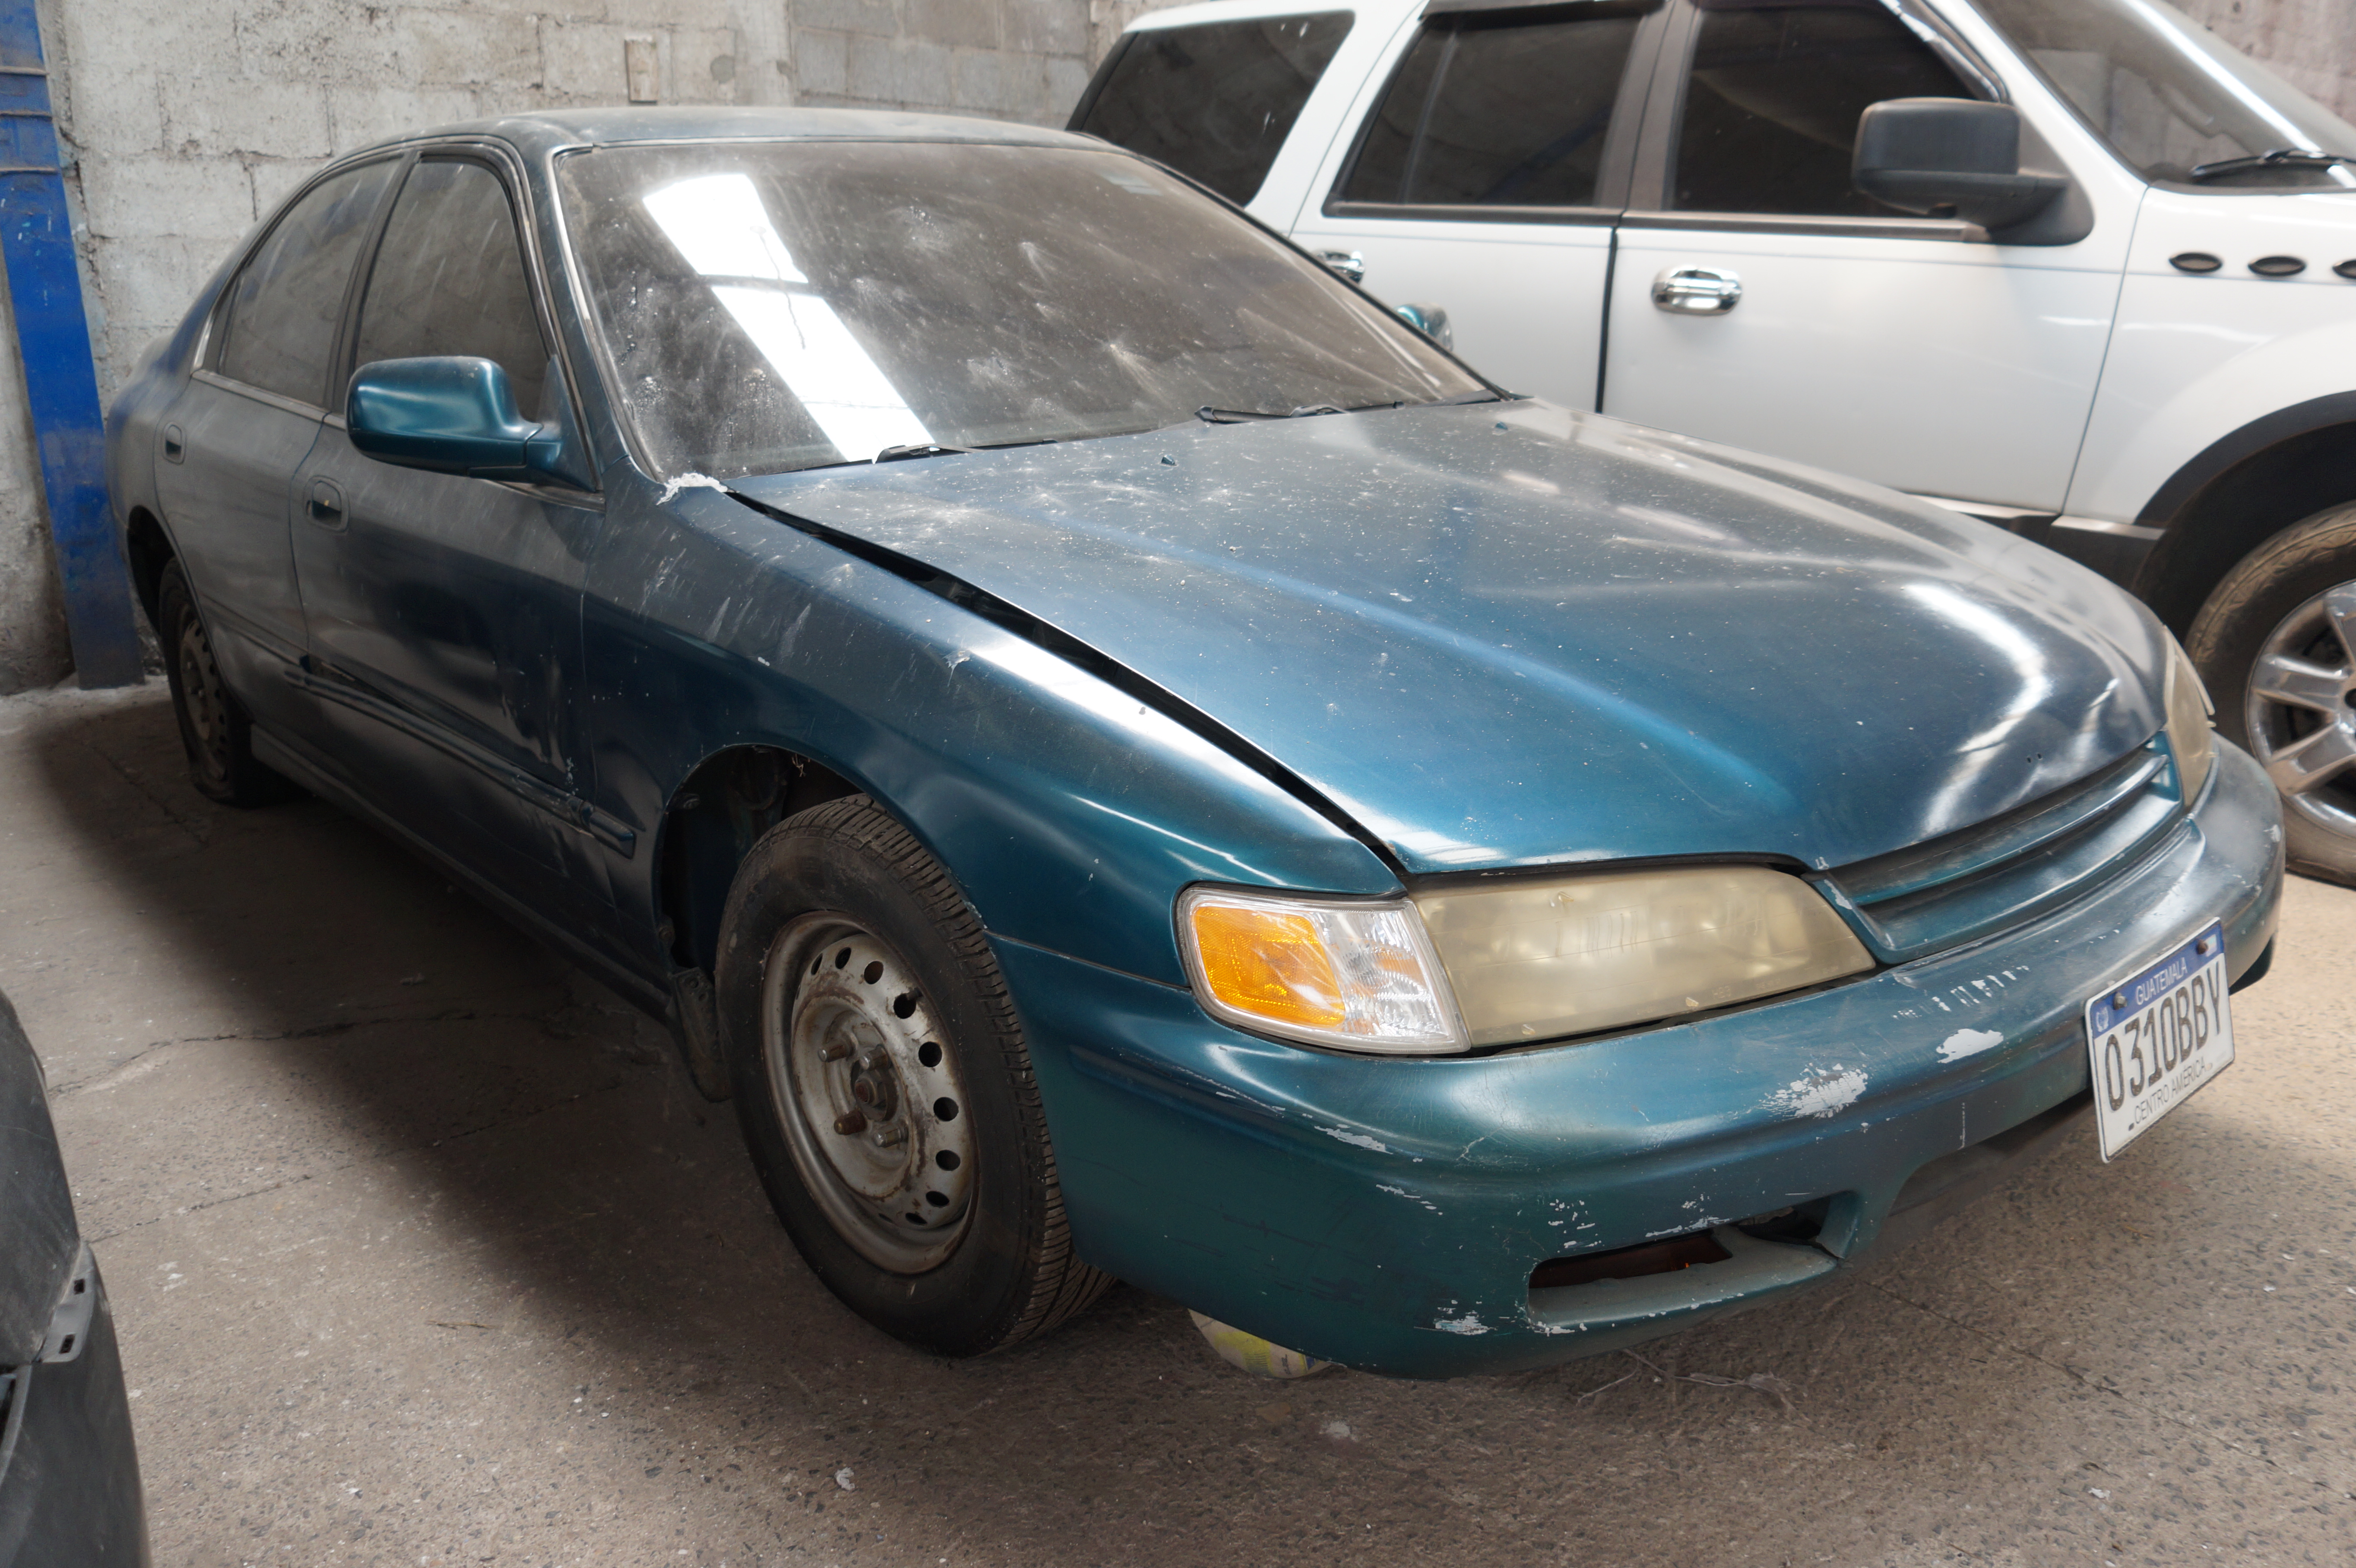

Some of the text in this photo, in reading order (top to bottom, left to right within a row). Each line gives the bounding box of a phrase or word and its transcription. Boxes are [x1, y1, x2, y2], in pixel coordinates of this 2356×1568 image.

[2135, 957, 2187, 1005] GUATEMALA
[2135, 1056, 2206, 1125] CENTRO AMÉRICA
